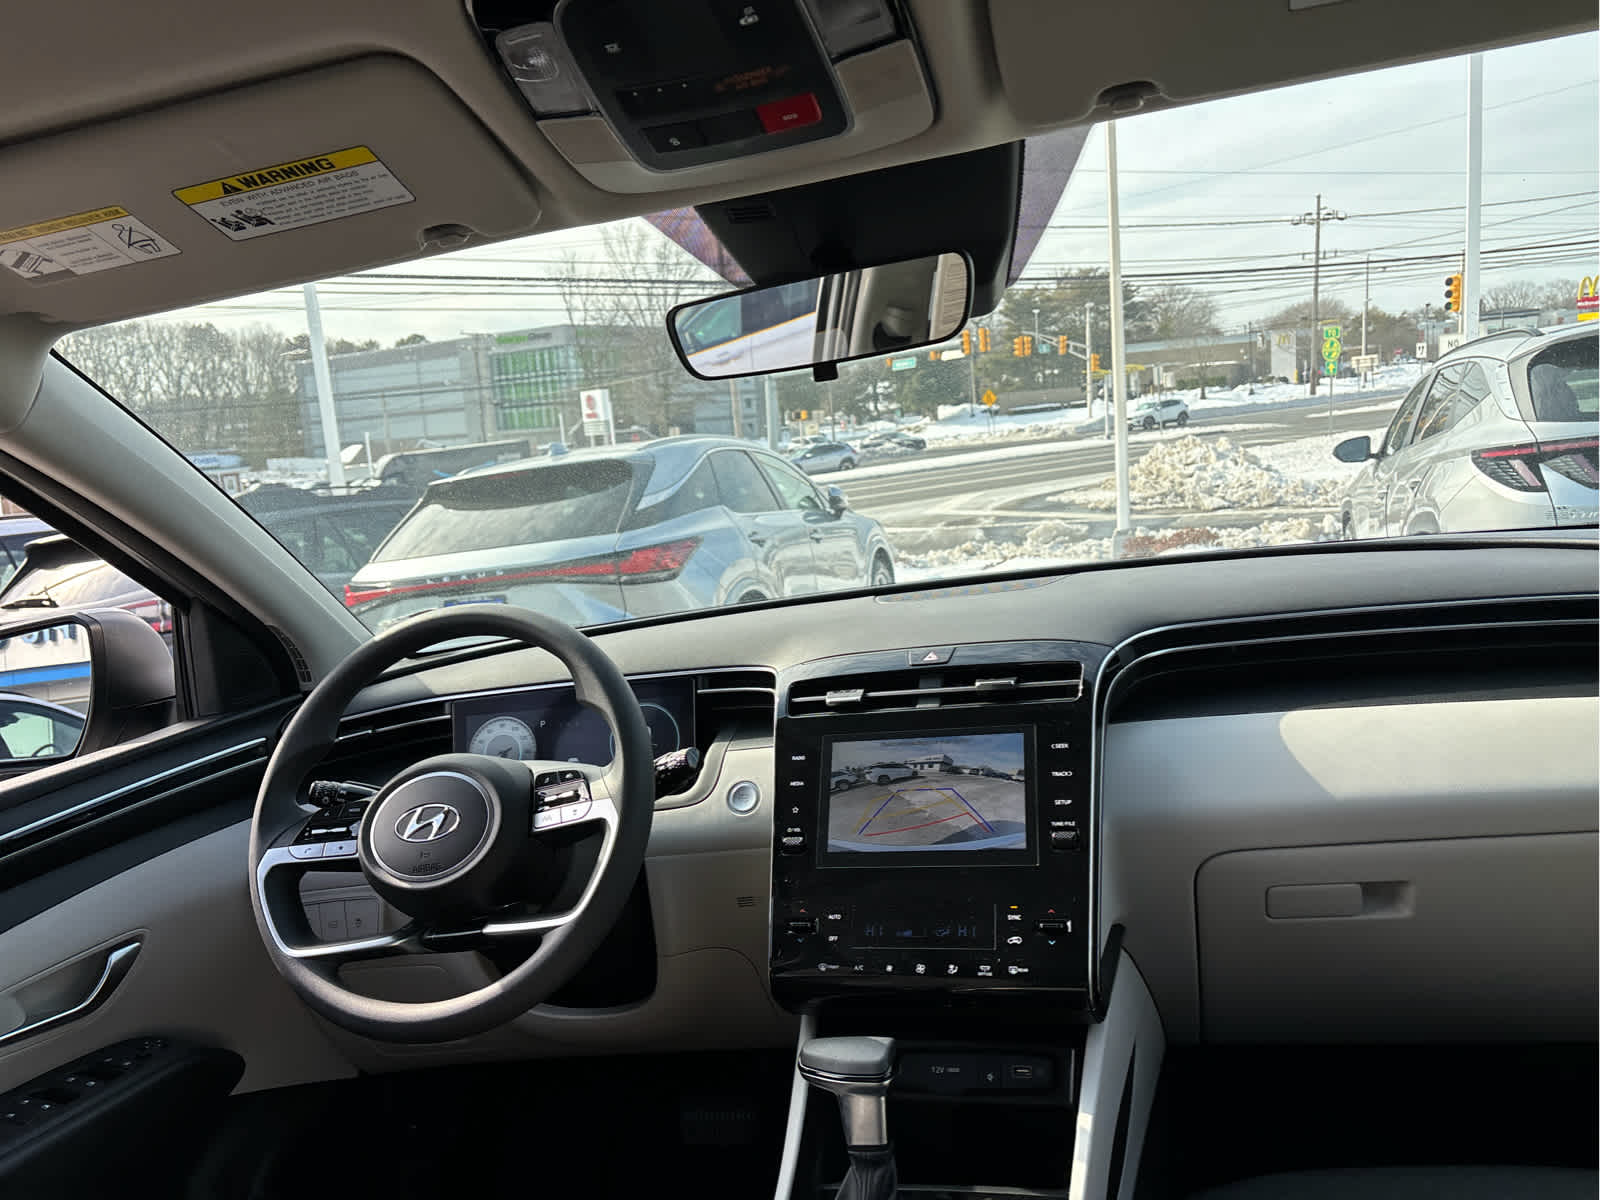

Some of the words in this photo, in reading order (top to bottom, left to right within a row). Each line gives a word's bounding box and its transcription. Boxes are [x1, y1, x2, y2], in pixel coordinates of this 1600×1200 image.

[236, 157, 336, 190] WARNING
[247, 190, 267, 201] WITH
[269, 180, 316, 196] ADVANCED
[317, 175, 332, 185] AIR
[335, 169, 360, 181] BAGS
[1447, 339, 1460, 348] NO
